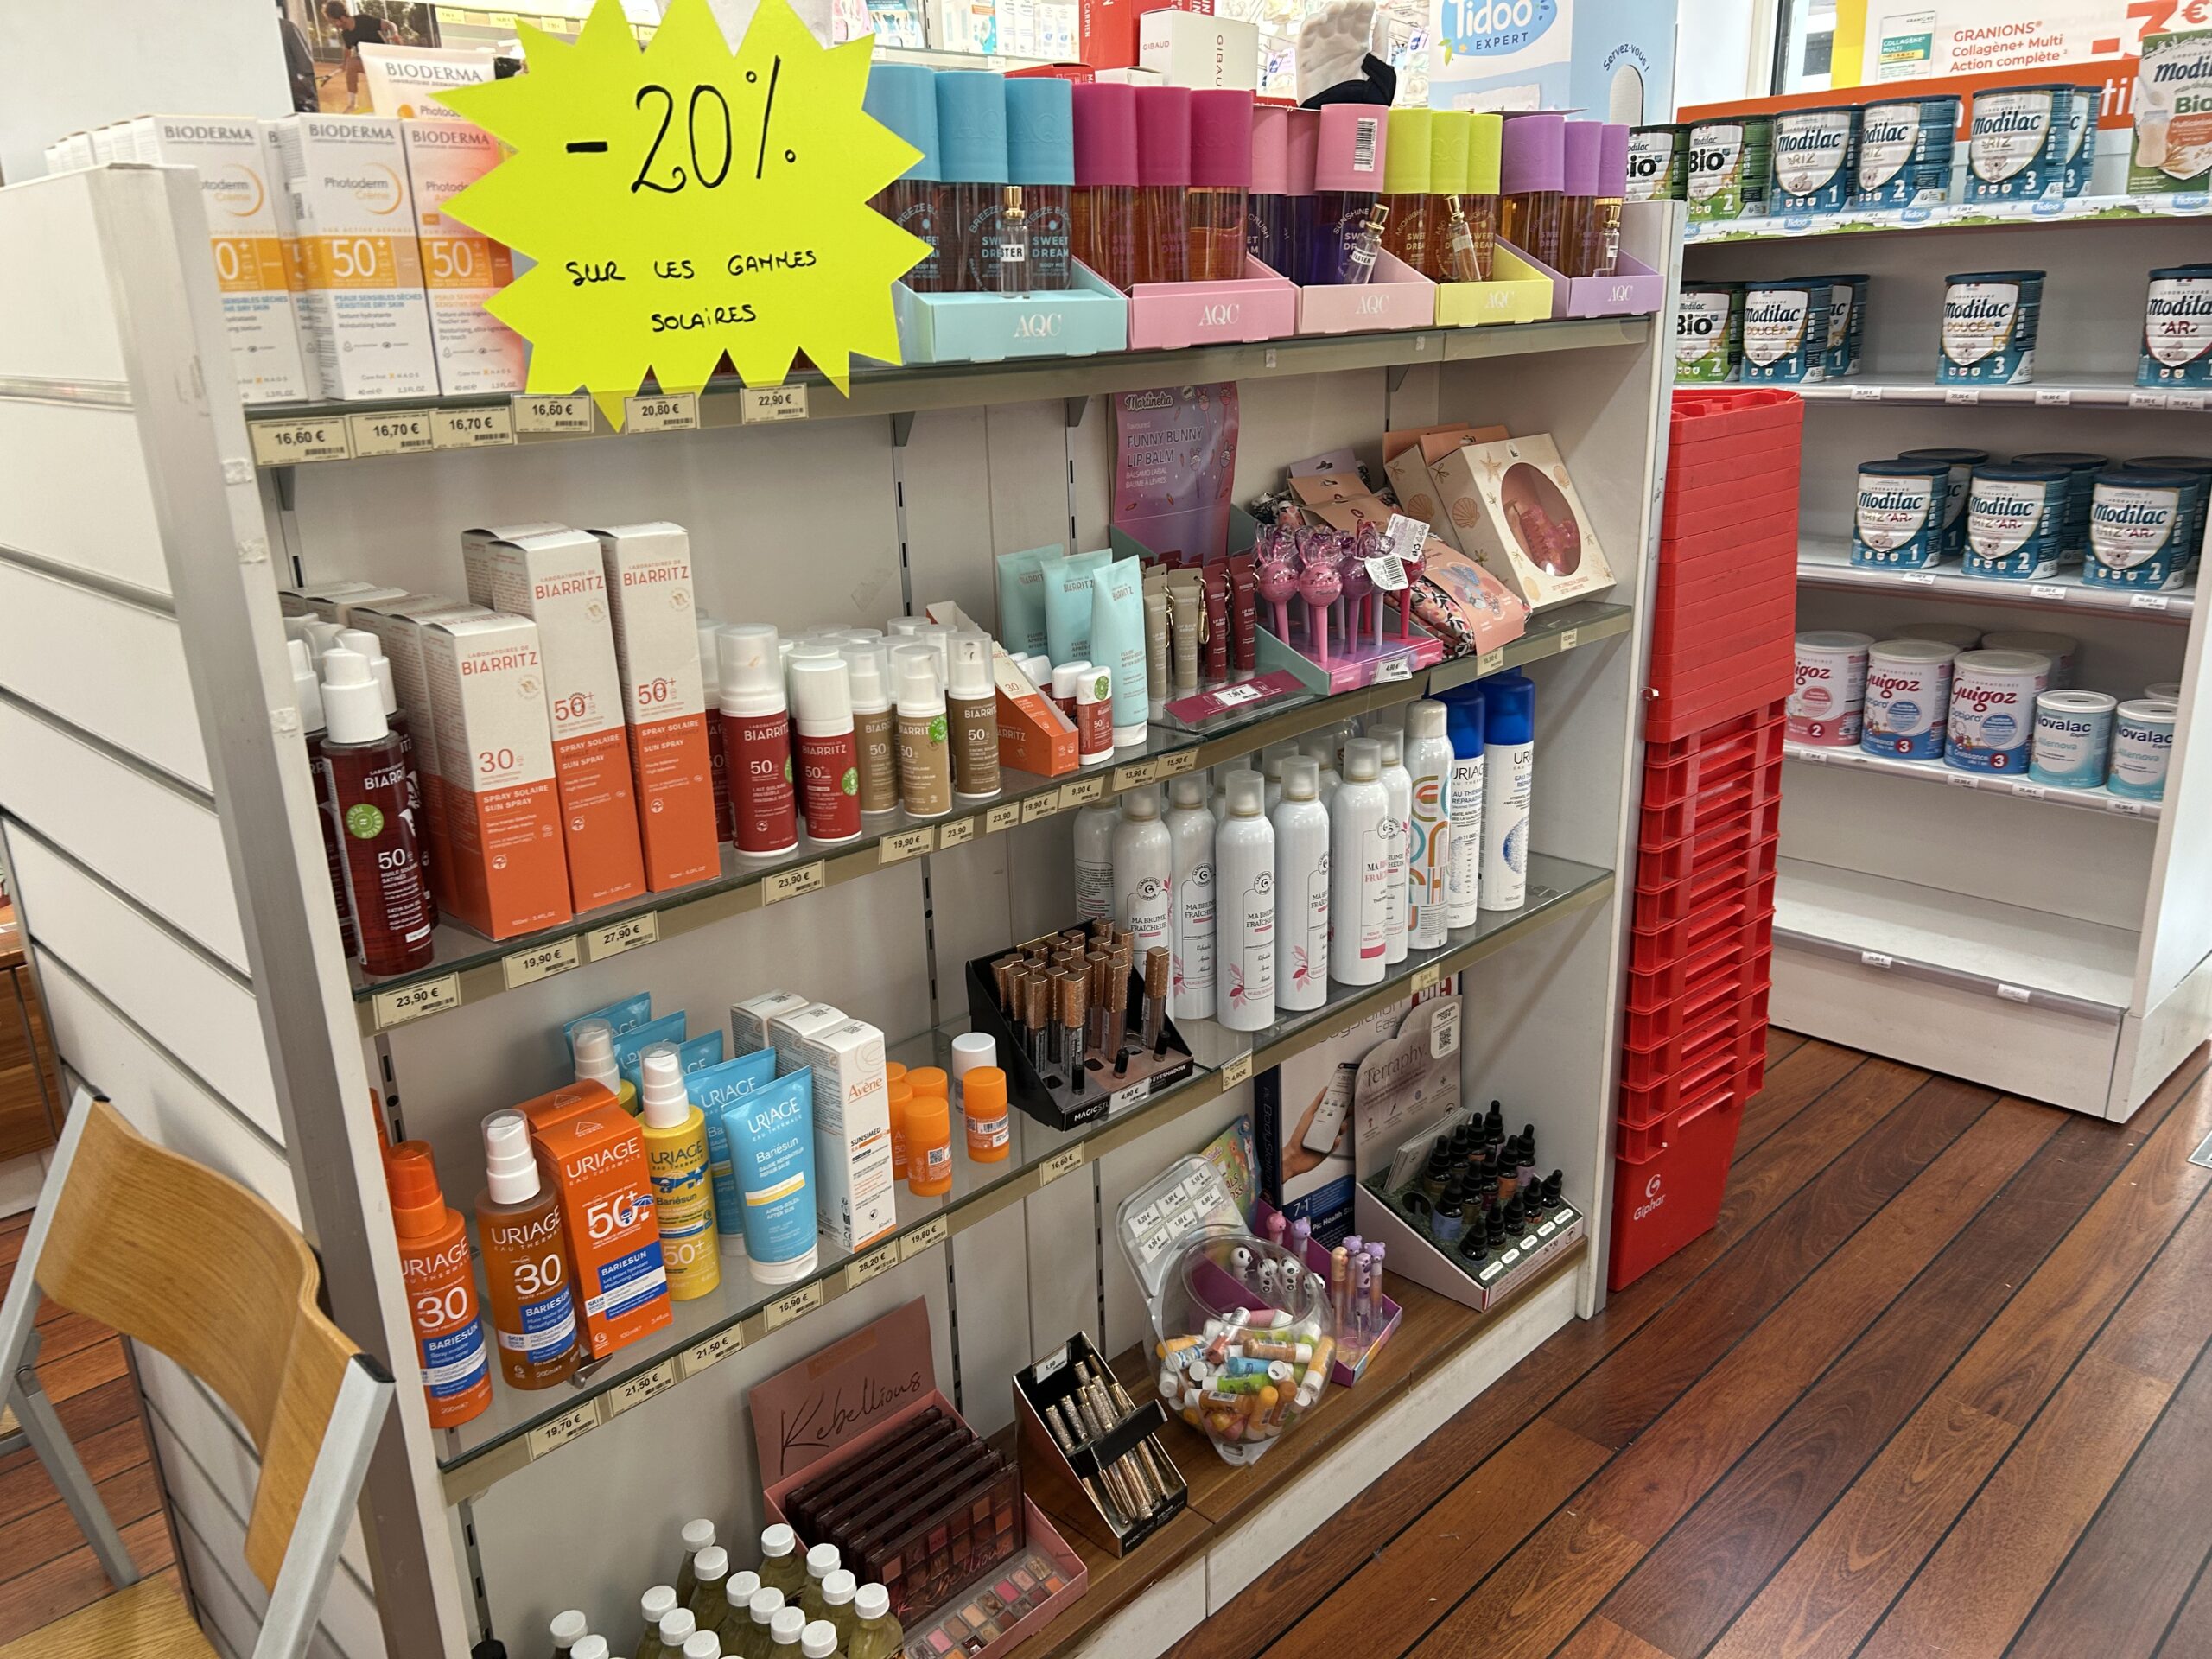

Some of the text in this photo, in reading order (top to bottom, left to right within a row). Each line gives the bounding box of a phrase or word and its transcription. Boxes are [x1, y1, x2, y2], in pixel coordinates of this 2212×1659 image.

[1448, 0, 1532, 39] Tidoo
[1142, 41, 1170, 50] GIBAUD
[1476, 32, 1529, 50] EXPERT
[1952, 34, 2063, 57] Collagène+ Multi
[1215, 35, 1224, 87] GIBAU
[1950, 59, 1992, 73] Action
[1996, 51, 2060, 67] complète
[385, 62, 483, 82] BIODERMA
[164, 126, 254, 140] BIODERMA
[309, 124, 395, 139] BIODERMA
[412, 131, 490, 145] BIODERMA
[1689, 149, 1726, 173] Bio
[324, 177, 388, 188] Photoderm
[1892, 180, 1906, 199] 2
[2024, 171, 2037, 190] 3
[1333, 207, 1369, 234] SUNSHINE
[1033, 236, 1068, 245] SWEET
[331, 238, 386, 277] 50+
[1033, 248, 1068, 258] DREAM
[566, 261, 626, 286] SUR
[654, 260, 695, 279] LES
[359, 293, 396, 302] SENSIBLES
[1608, 285, 1634, 302] AQC
[1198, 303, 1240, 327] AQC
[1354, 295, 1389, 315] AQC
[2147, 295, 2212, 317] Modila
[1013, 314, 1062, 337] AQC
[1676, 314, 1713, 335] Bio
[2163, 321, 2189, 335] AR
[1993, 355, 2005, 375] 3
[641, 404, 679, 416] 20,80 €
[1126, 392, 1173, 410] Martinelia
[372, 423, 421, 439] 16,70 €
[448, 416, 494, 432] 16,70 €
[274, 429, 327, 446] 16,60 €
[1127, 427, 1204, 448] FUNNY BUNNY
[1127, 448, 1174, 467] LIP BALM
[623, 565, 689, 587] BIARRITZ
[535, 575, 604, 600] BIARRITZ
[461, 652, 538, 676] BIARRITZ
[1951, 678, 2018, 713] Guigoz
[641, 720, 699, 737] SPRAY SOLAIRE
[968, 728, 985, 741] 50
[560, 734, 620, 753] SPRAY SOLAIRE
[643, 739, 684, 753] SUN SPRAY
[802, 744, 847, 755] BIARRITZ
[869, 743, 887, 756] 50
[478, 748, 515, 773] 30
[562, 754, 605, 770] SUN SPRAY
[750, 760, 773, 774] 50
[1996, 753, 2005, 767] 3
[483, 785, 550, 804] SPRAY SOLAIRE
[484, 798, 532, 813] SUN SPRAY
[991, 810, 1011, 823] 23,90
[946, 825, 967, 838] 23,90
[378, 849, 406, 870] 50
[1144, 913, 1166, 923] BRUME
[603, 924, 640, 944] 27,90 €
[523, 949, 562, 969] 19,90 €
[396, 988, 440, 1008] 23,90 €
[1152, 1064, 1187, 1083] EYESHADOW
[848, 1077, 882, 1101] Avène
[747, 1097, 801, 1135] URIAGE
[850, 1126, 881, 1147] SUNSIMED
[566, 1136, 641, 1179] URIAGE
[650, 1140, 703, 1166] URIAGE
[756, 1136, 799, 1164] Bariésun
[569, 1154, 642, 1186] EAU THERMALE
[656, 1192, 697, 1206] Bariésun
[1633, 1194, 1666, 1221] Giphar
[491, 1204, 562, 1246] URIAGE
[1311, 1212, 1344, 1231] Pic Health
[513, 1253, 562, 1294] 30
[601, 1250, 647, 1277] BARIESUN
[416, 1286, 468, 1329] 30
[525, 1289, 570, 1317] BARIESUN
[779, 1293, 809, 1313] 16,90 €
[429, 1322, 478, 1351] BARIESUN
[696, 1338, 729, 1359] 21,50 €
[625, 1375, 659, 1396] 21,50 €
[545, 1414, 582, 1439] 19,70 €
[779, 1370, 922, 1476] Rebellious
